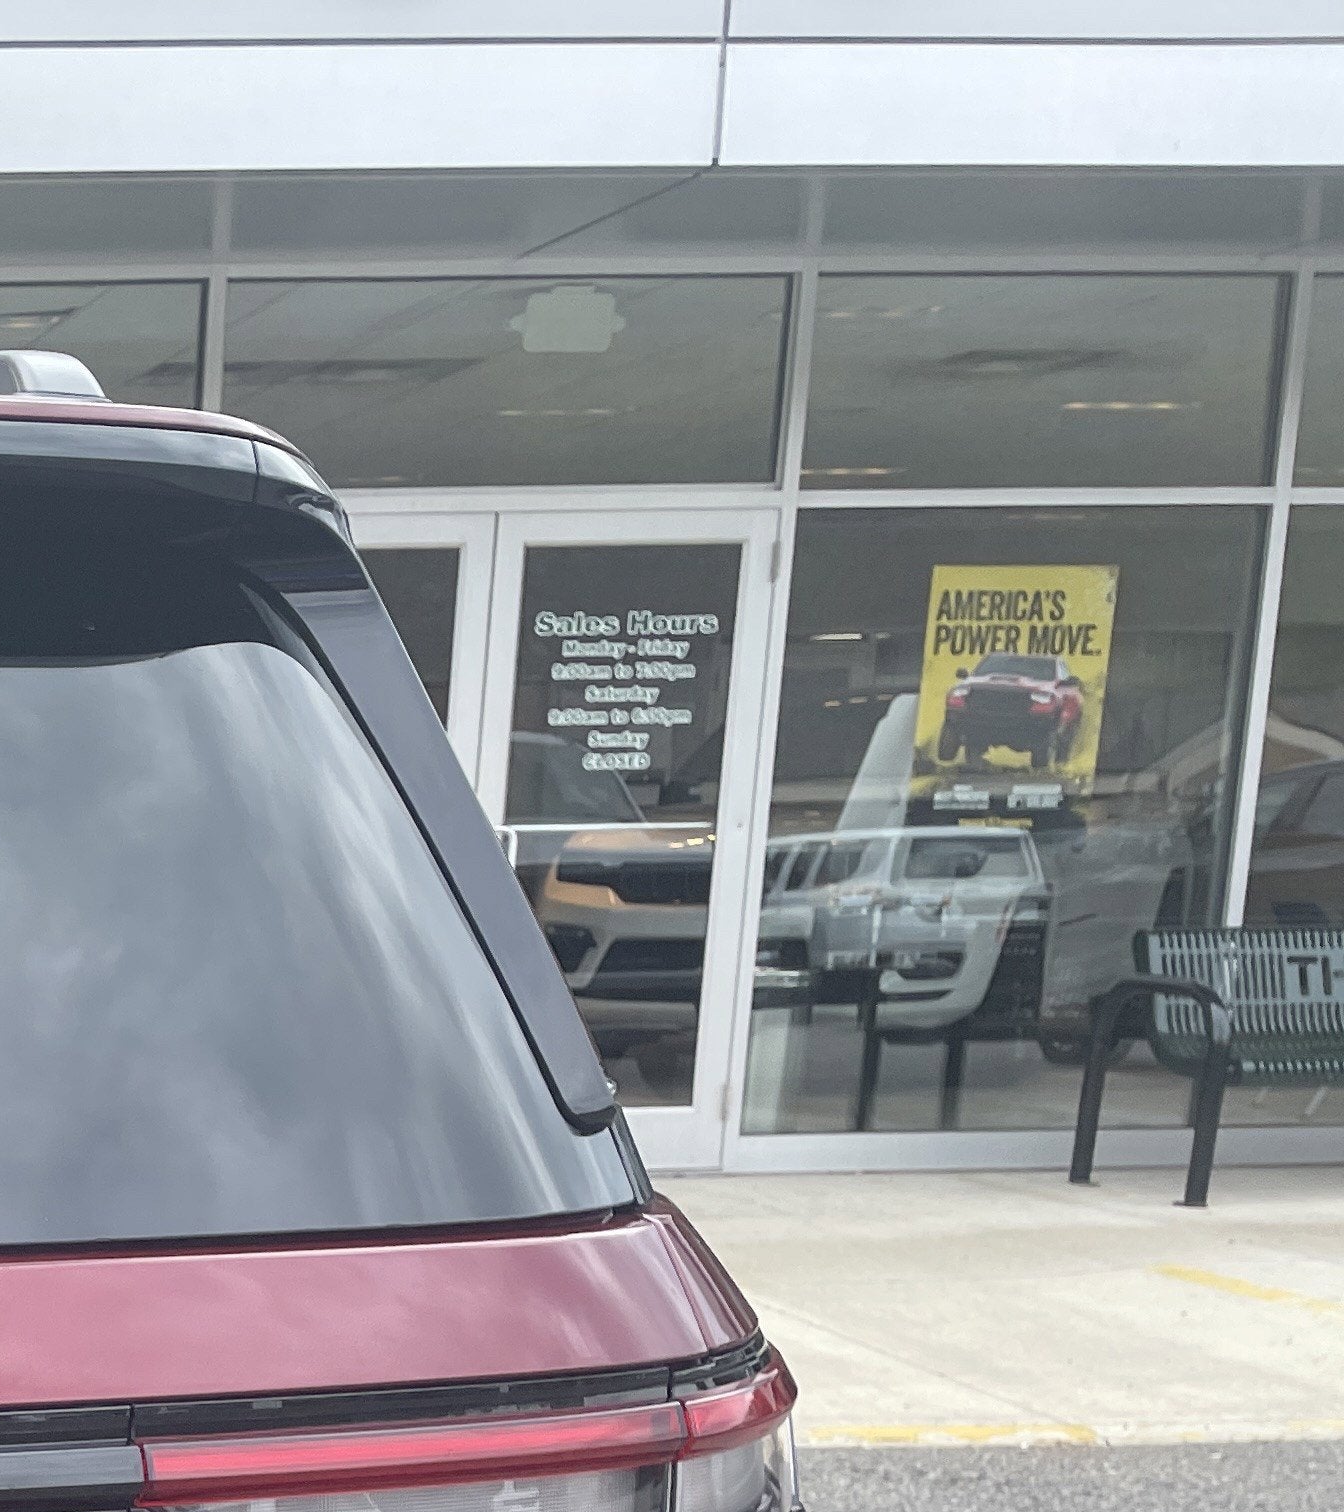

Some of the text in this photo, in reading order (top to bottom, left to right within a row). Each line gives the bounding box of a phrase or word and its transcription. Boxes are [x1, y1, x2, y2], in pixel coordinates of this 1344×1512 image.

[936, 589, 1066, 622] AMERICA'S
[534, 610, 719, 637] Sales Hours
[933, 624, 1102, 656] POWER MOVE.
